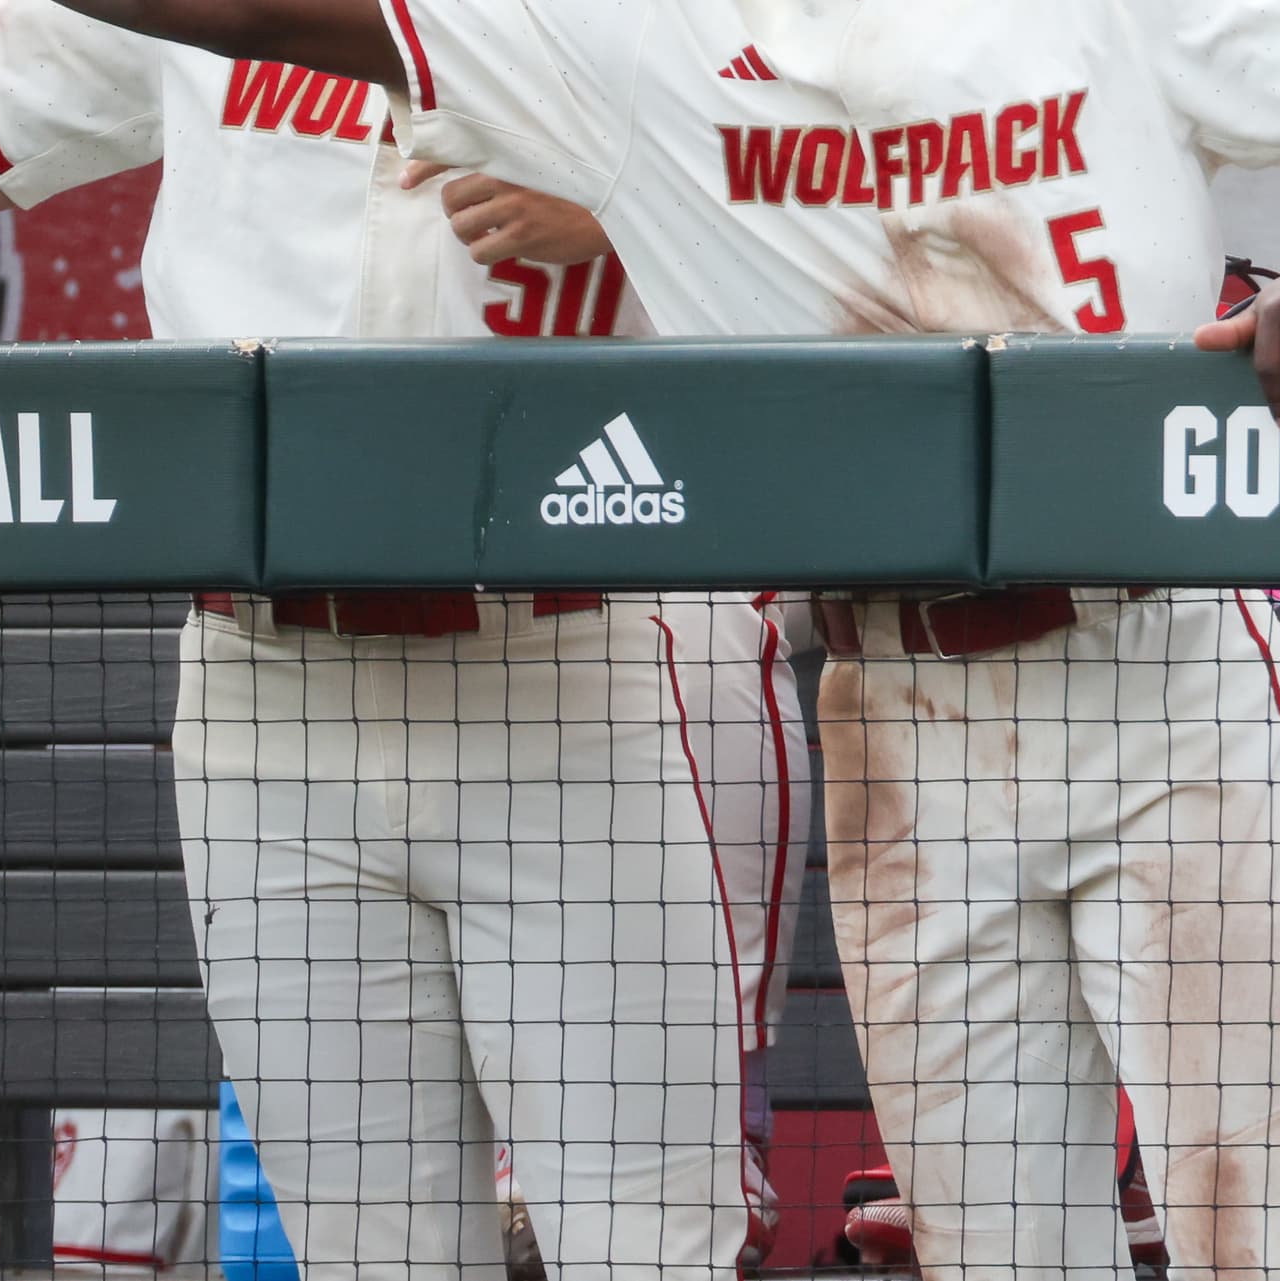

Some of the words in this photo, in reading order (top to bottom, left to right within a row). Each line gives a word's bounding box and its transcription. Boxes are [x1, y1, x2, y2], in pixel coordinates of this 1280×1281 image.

[713, 87, 1089, 214] WOLFPACK
[1045, 205, 1128, 334] 5
[540, 483, 685, 526] adidas
